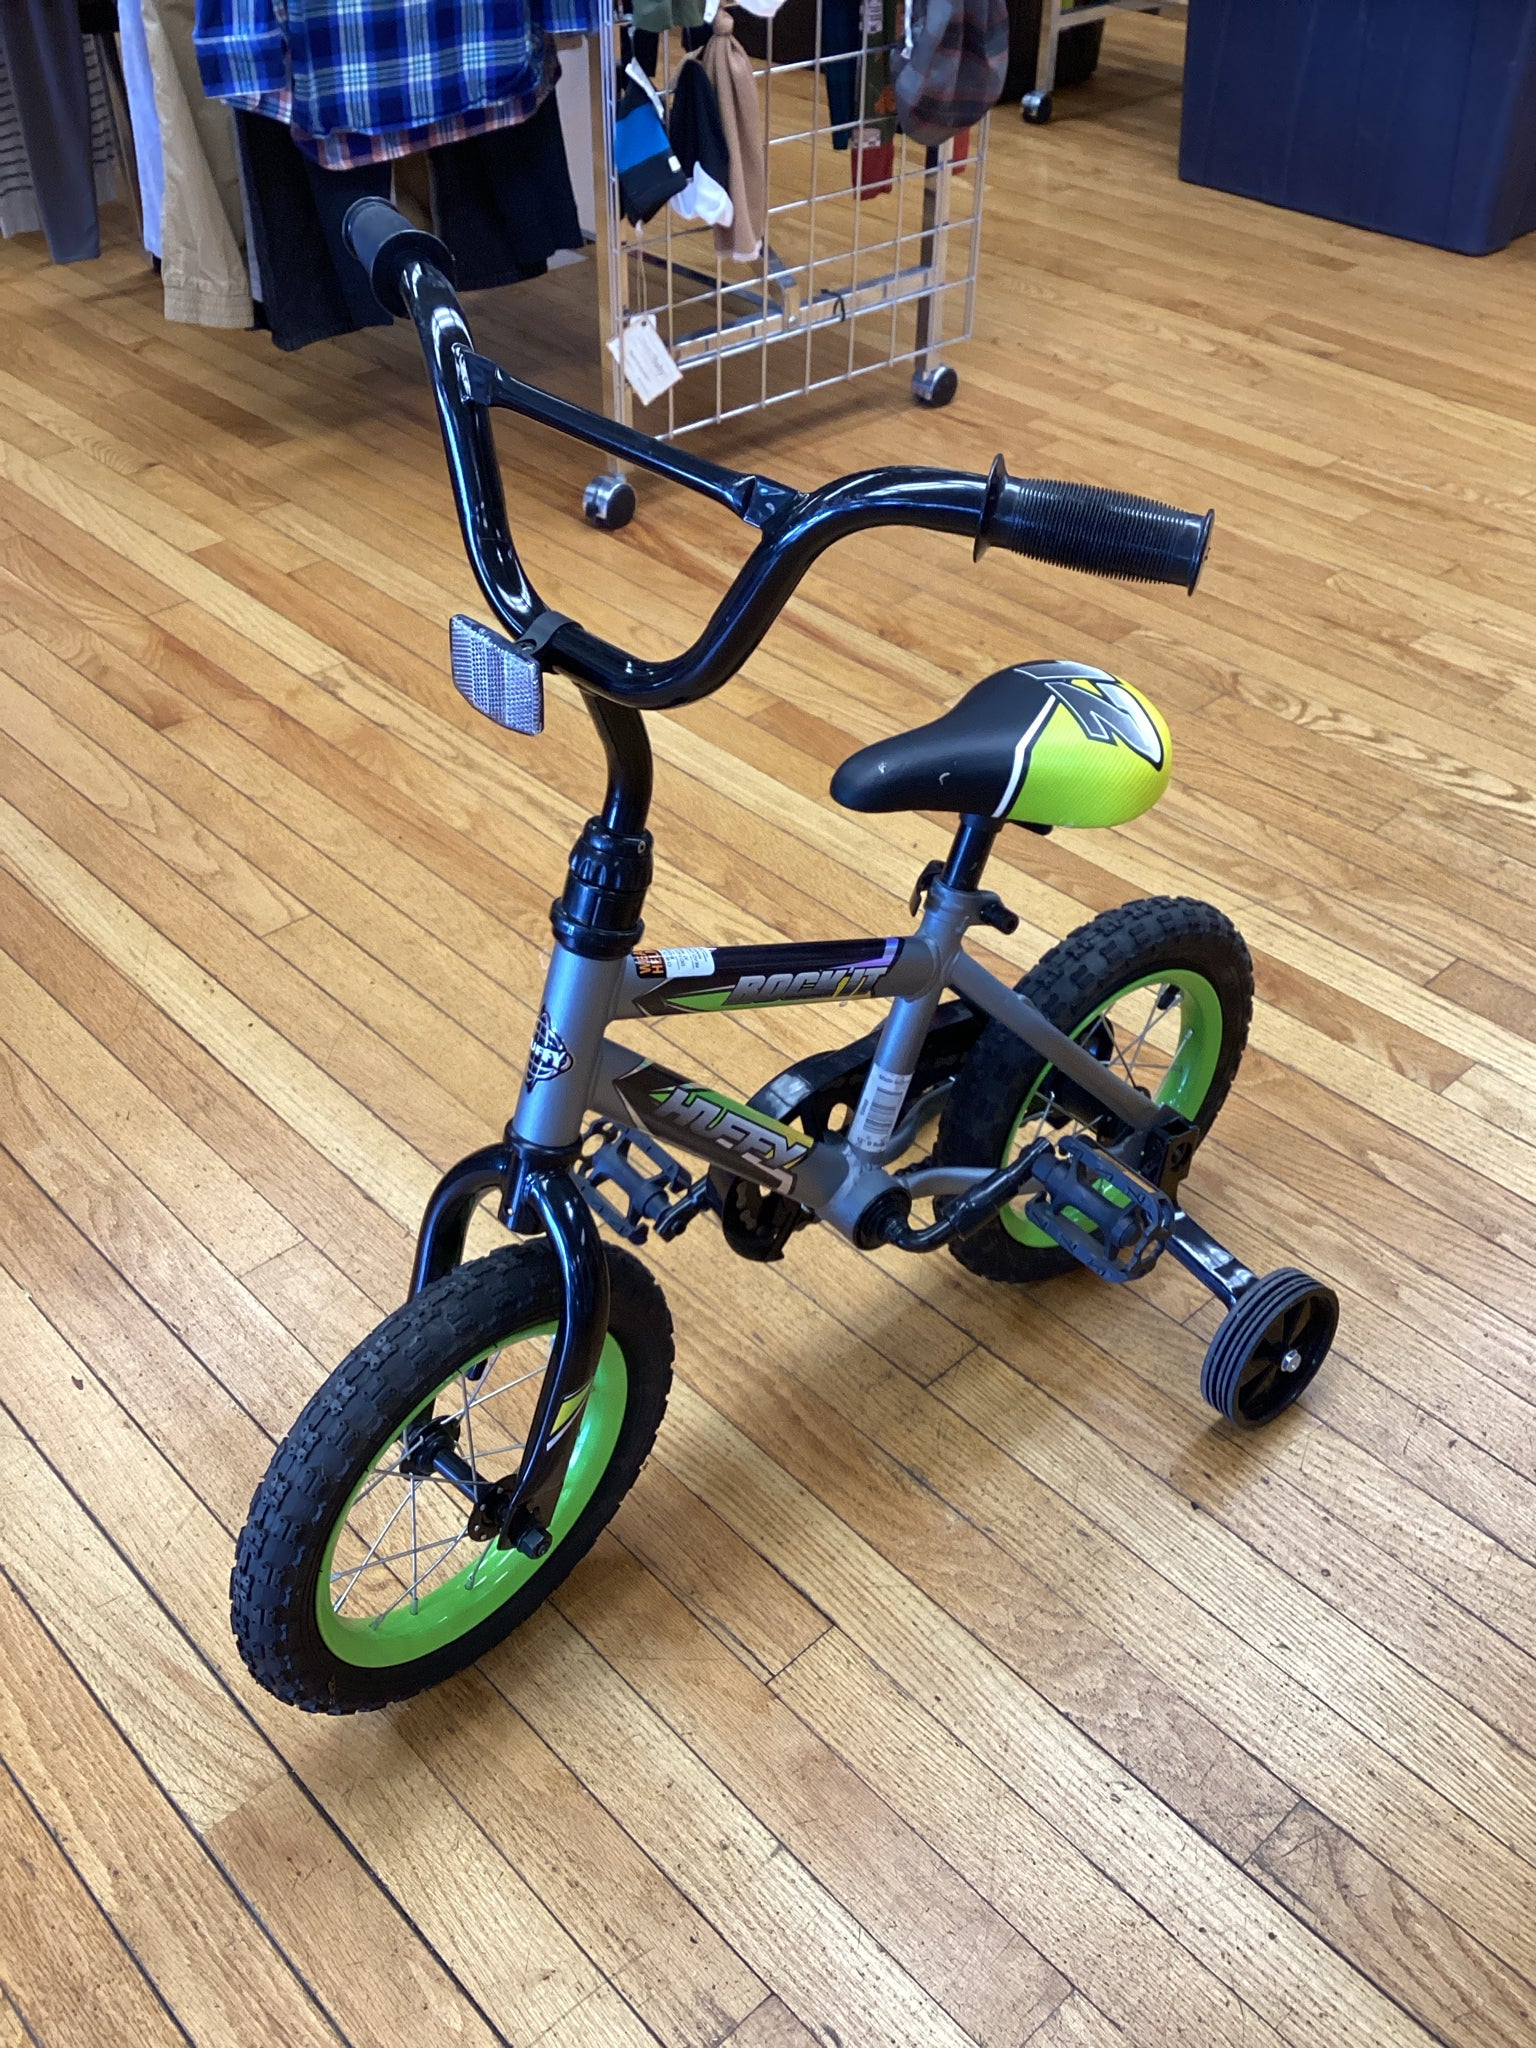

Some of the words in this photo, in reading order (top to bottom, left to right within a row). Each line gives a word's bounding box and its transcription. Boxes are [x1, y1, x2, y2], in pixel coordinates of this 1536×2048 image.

[632, 950, 651, 974] WEA
[530, 1036, 567, 1067] UFFY
[656, 1087, 808, 1169] HUFFY
